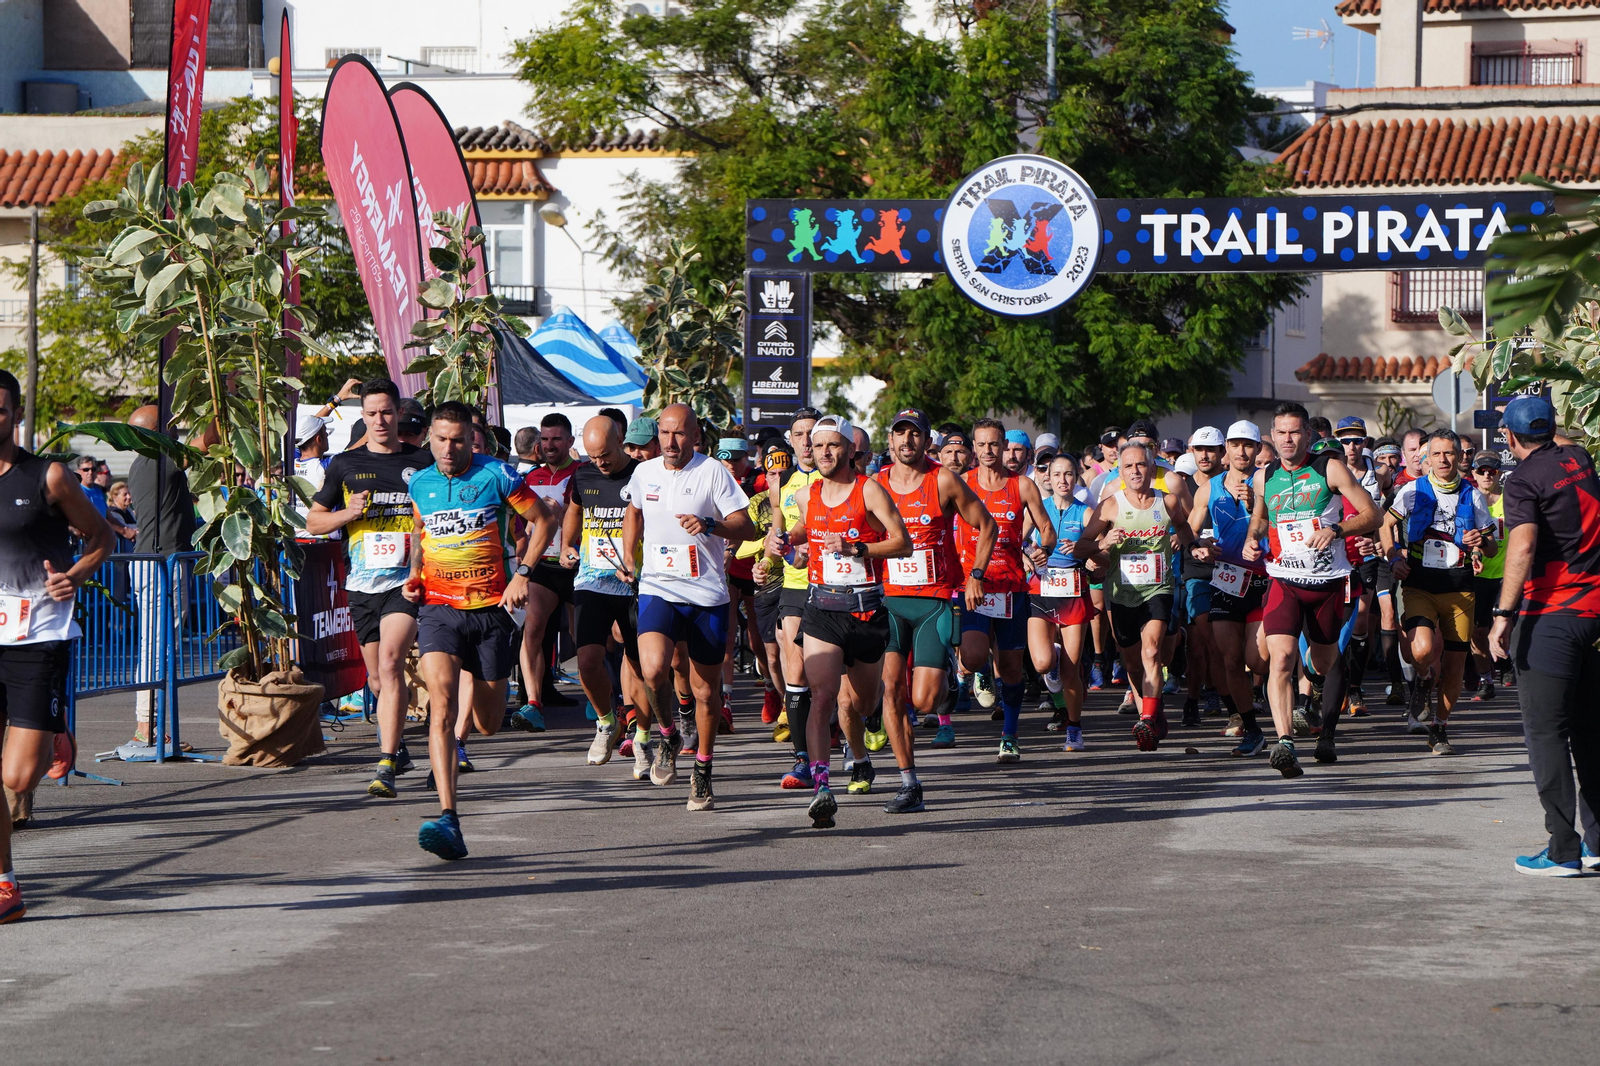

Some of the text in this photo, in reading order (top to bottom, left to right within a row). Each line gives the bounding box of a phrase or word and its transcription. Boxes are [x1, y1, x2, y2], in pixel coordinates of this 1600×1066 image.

[956, 165, 1088, 222] TRAIL PIRATA
[1140, 212, 1303, 257] TRAIL
[951, 238, 1090, 306] SIERRA SAN CRISTOBAL 2023
[757, 347, 795, 356] INAUTO
[752, 381, 799, 389] LIBERTIUM
[433, 511, 461, 525] TRAIL
[1290, 531, 1304, 542] 53
[373, 543, 396, 556] 359
[666, 556, 674, 567] 2
[688, 550, 697, 573] PIRATA
[896, 562, 918, 573] 155
[434, 565, 495, 581] Algeciras
[836, 562, 852, 574] 23
[1128, 564, 1149, 574] 250
[1048, 577, 1068, 587] 438
[1218, 571, 1236, 584] 439
